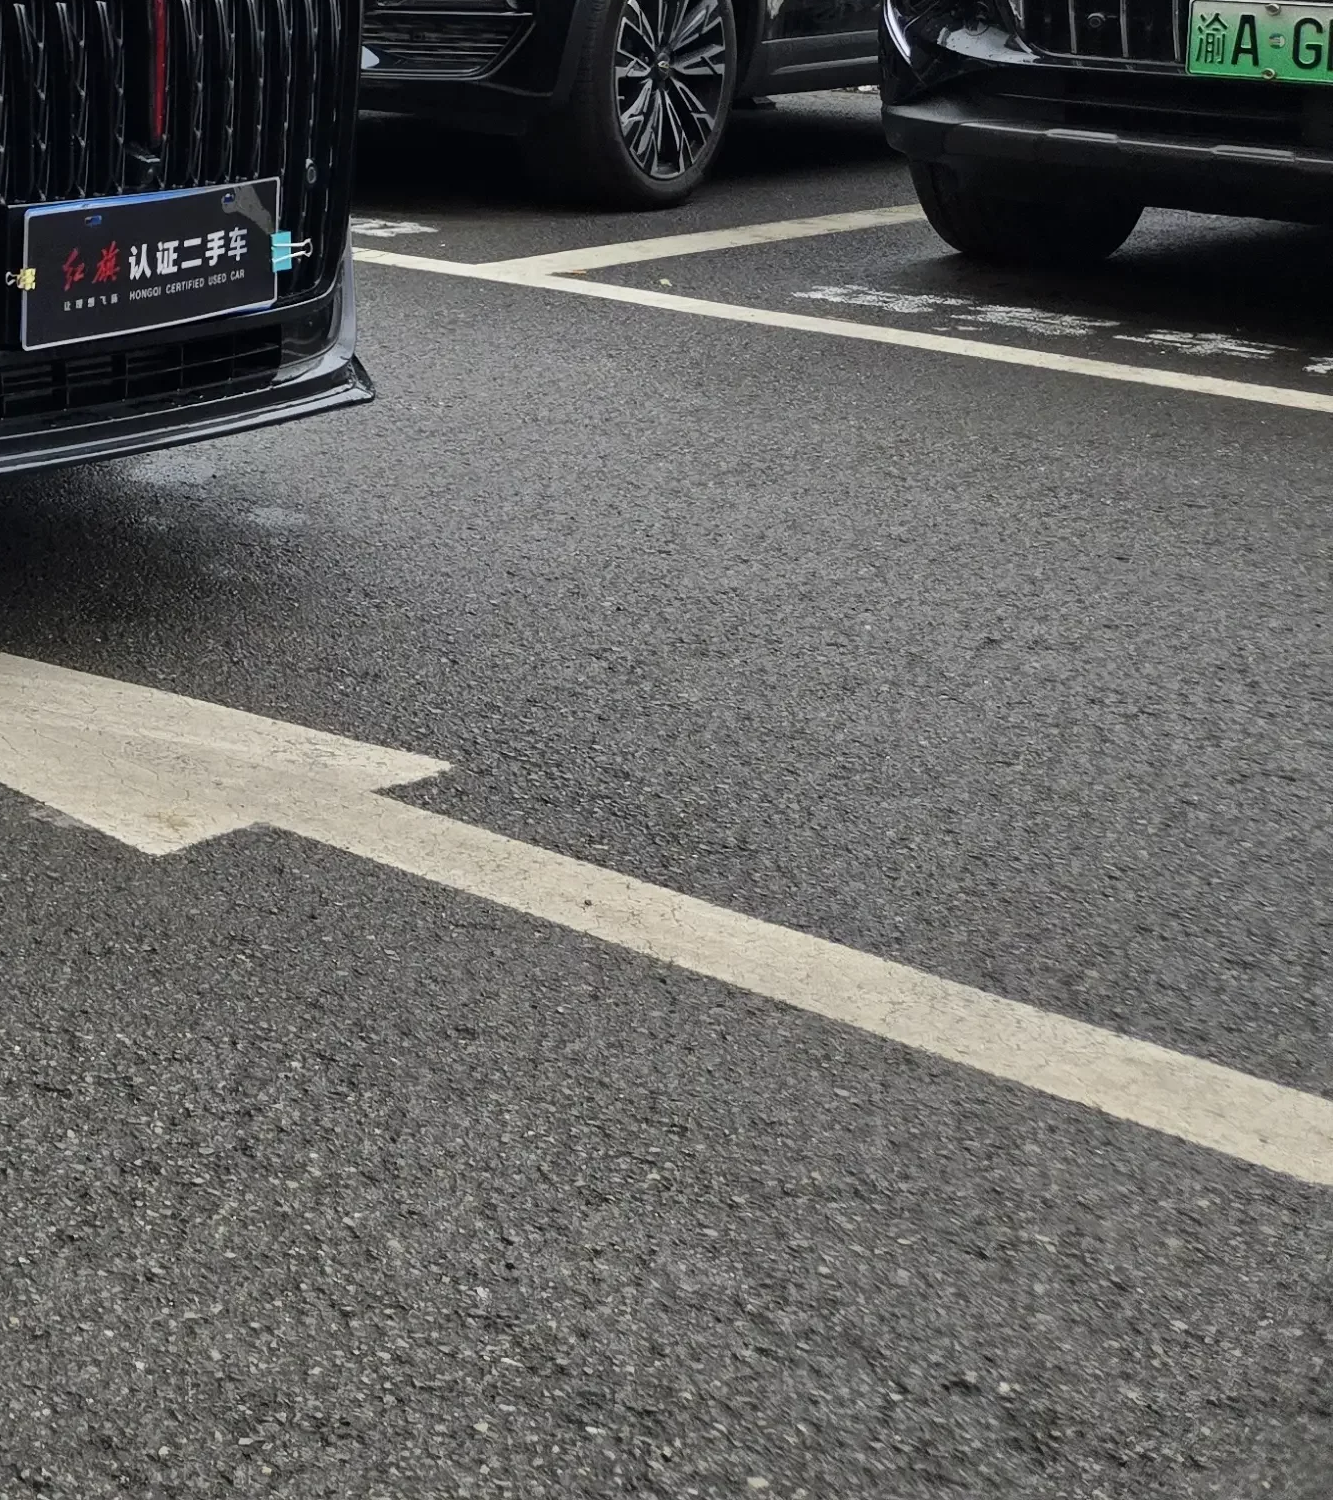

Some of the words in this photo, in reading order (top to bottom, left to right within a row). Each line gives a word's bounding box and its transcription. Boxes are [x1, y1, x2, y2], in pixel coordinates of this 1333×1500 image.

[165, 278, 205, 295] CERTIFIED
[207, 274, 227, 287] USED
[230, 268, 245, 281] CAR
